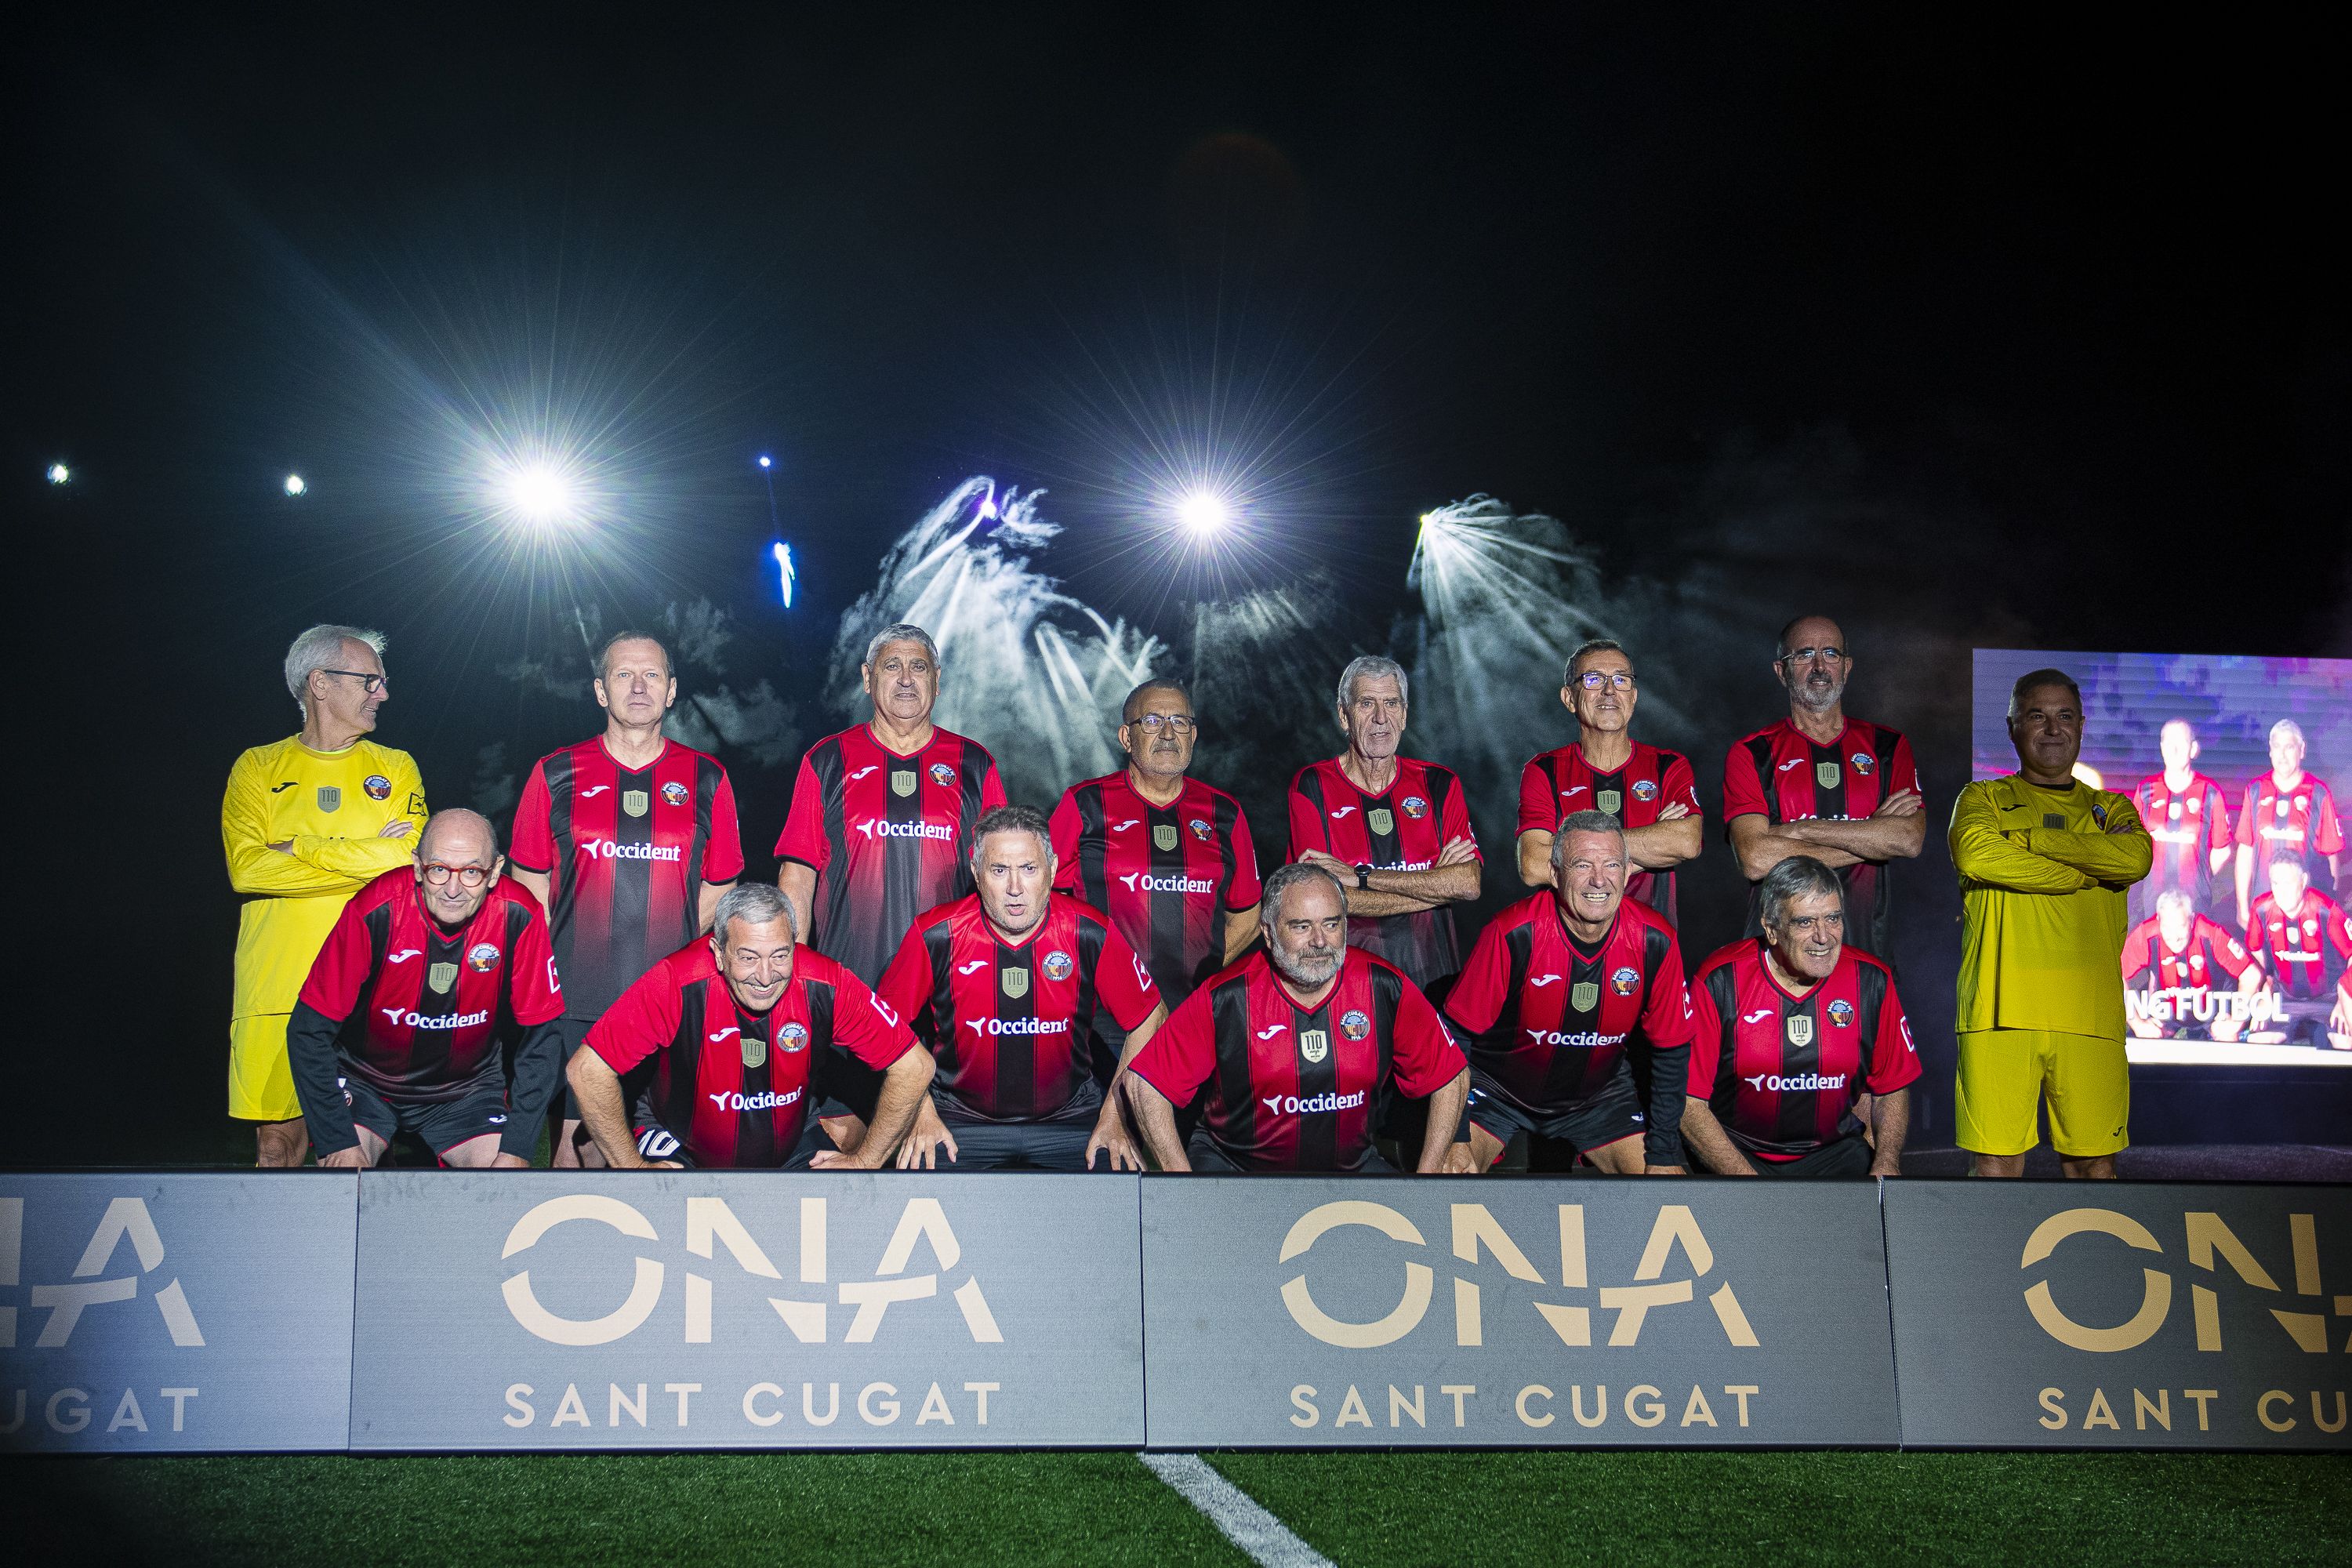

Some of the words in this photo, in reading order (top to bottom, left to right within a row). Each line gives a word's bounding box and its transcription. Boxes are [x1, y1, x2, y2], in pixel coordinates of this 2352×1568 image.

[897, 775, 911, 786] 110
[1821, 766, 1835, 779] 110
[321, 789, 336, 802] 110
[629, 794, 643, 807] 110
[1602, 793, 1616, 805] 110
[1373, 812, 1388, 825] 110
[877, 820, 953, 841] Occident
[1159, 829, 1172, 840] 110
[602, 841, 681, 861] Occident
[1141, 874, 1214, 894] Occident
[436, 967, 452, 981] 110
[1007, 971, 1023, 985] 110
[1578, 987, 1593, 1000] 110
[2176, 990, 2288, 1022] FUTBOL
[405, 1010, 488, 1029] Occident
[987, 1017, 1069, 1035] Occident
[1791, 1019, 1808, 1034] 110
[1305, 1034, 1323, 1050] 110
[1547, 1031, 1627, 1046] Occident
[744, 1043, 760, 1056] 110
[1766, 1073, 1846, 1091] Occident
[1284, 1090, 1365, 1113] Occident
[502, 1194, 1004, 1346] ONA
[1279, 1200, 1761, 1348] ONA
[2021, 1208, 2352, 1353] ON
[503, 1382, 702, 1428] SANT
[742, 1381, 1000, 1427] CUGAT
[1290, 1384, 1476, 1428] SANT
[1515, 1384, 1759, 1428] CUGAT
[2038, 1387, 2219, 1432] SANT
